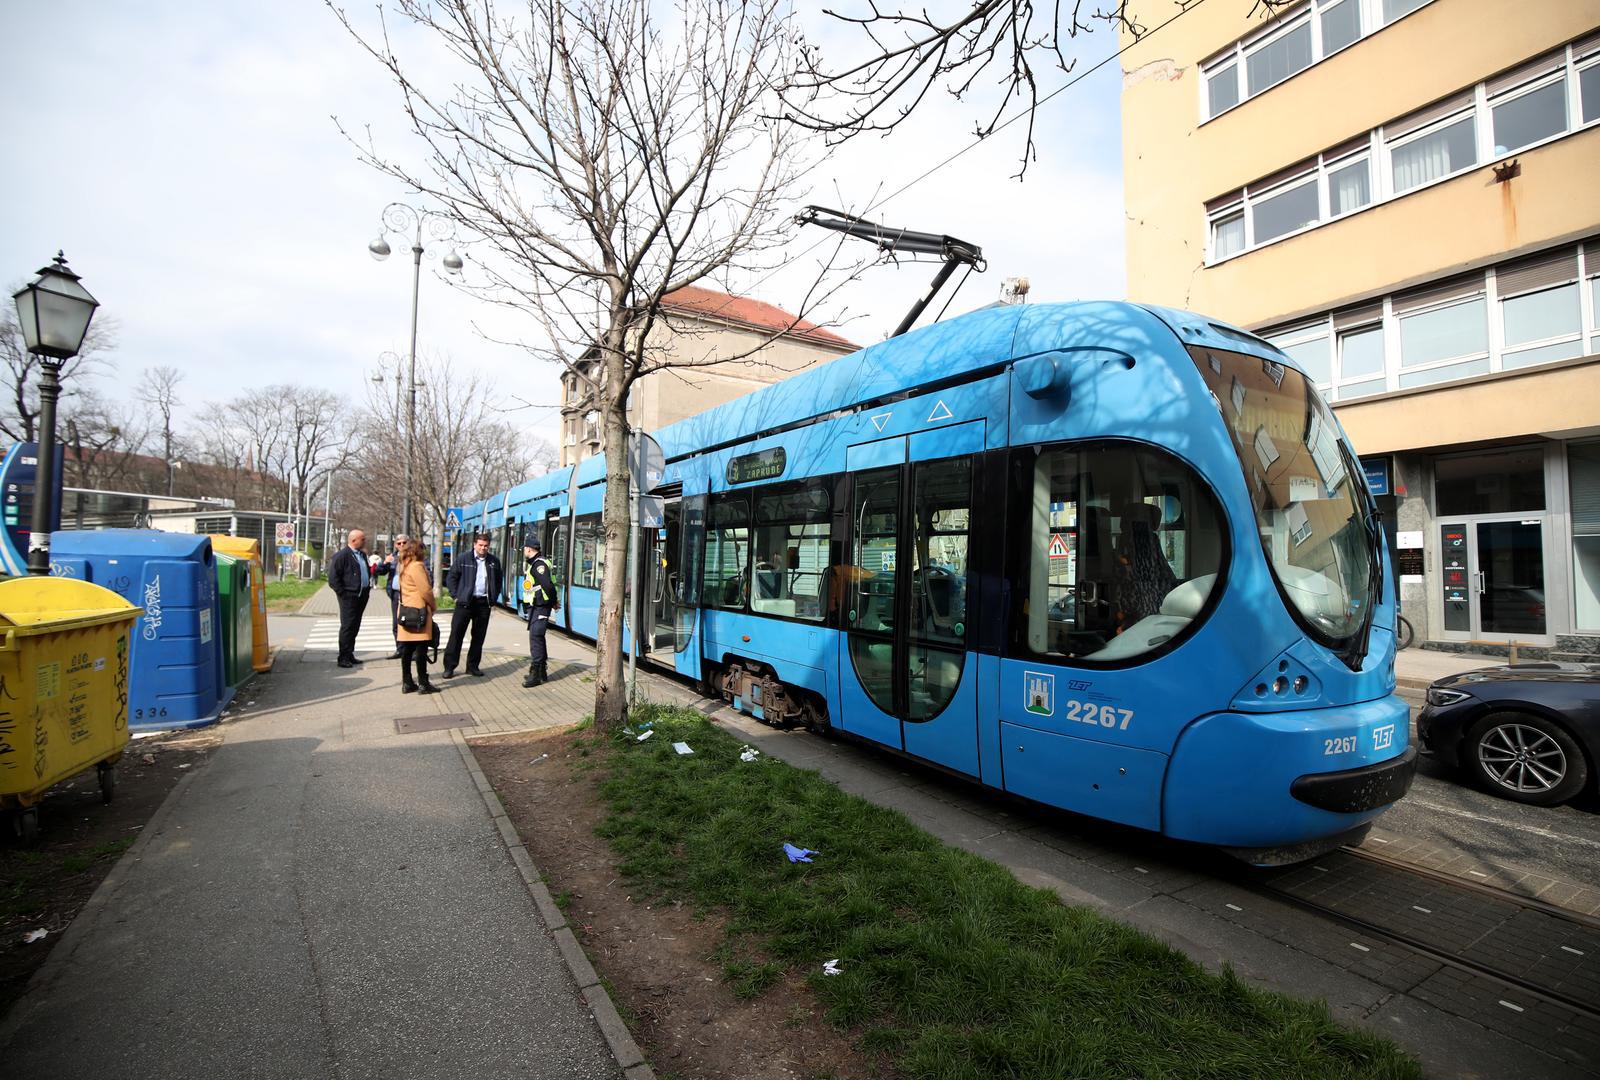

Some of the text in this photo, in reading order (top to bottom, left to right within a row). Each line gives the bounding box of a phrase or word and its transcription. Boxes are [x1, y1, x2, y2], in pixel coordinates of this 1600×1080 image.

[135, 706, 168, 720] 336
[1066, 699, 1135, 731] 2267
[1324, 723, 1395, 756] 2267 ZET
